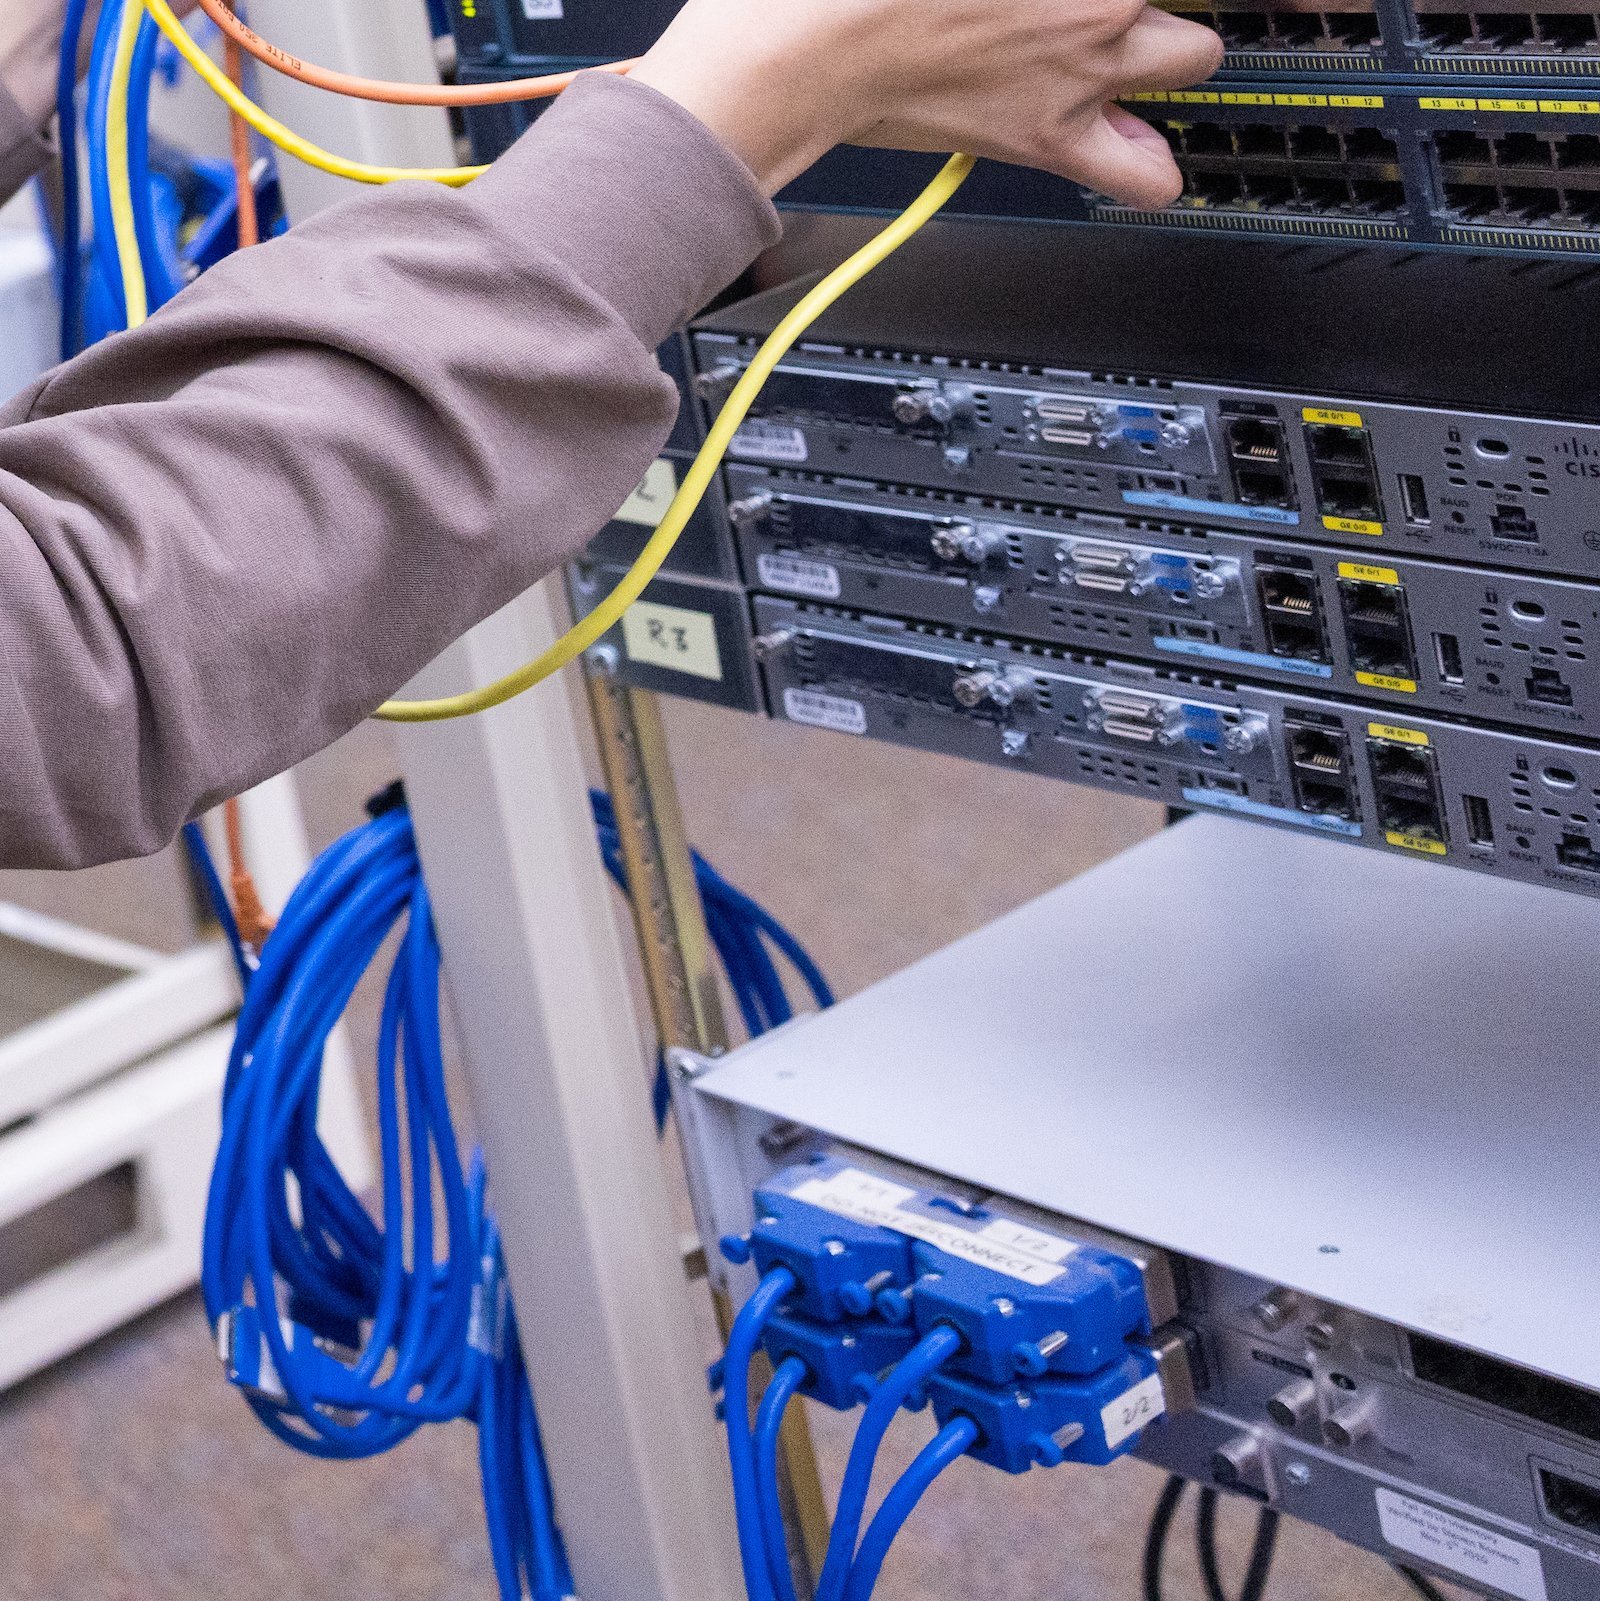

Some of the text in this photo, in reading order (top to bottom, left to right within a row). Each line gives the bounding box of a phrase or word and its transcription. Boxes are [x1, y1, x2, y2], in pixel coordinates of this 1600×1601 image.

[266, 45, 301, 71] ELITE
[1440, 496, 1470, 508] BAUD
[1496, 493, 1518, 502] POE
[1250, 510, 1288, 522] CONSOLE
[1444, 525, 1475, 535] RESET
[1121, 1396, 1150, 1425] 2/2
